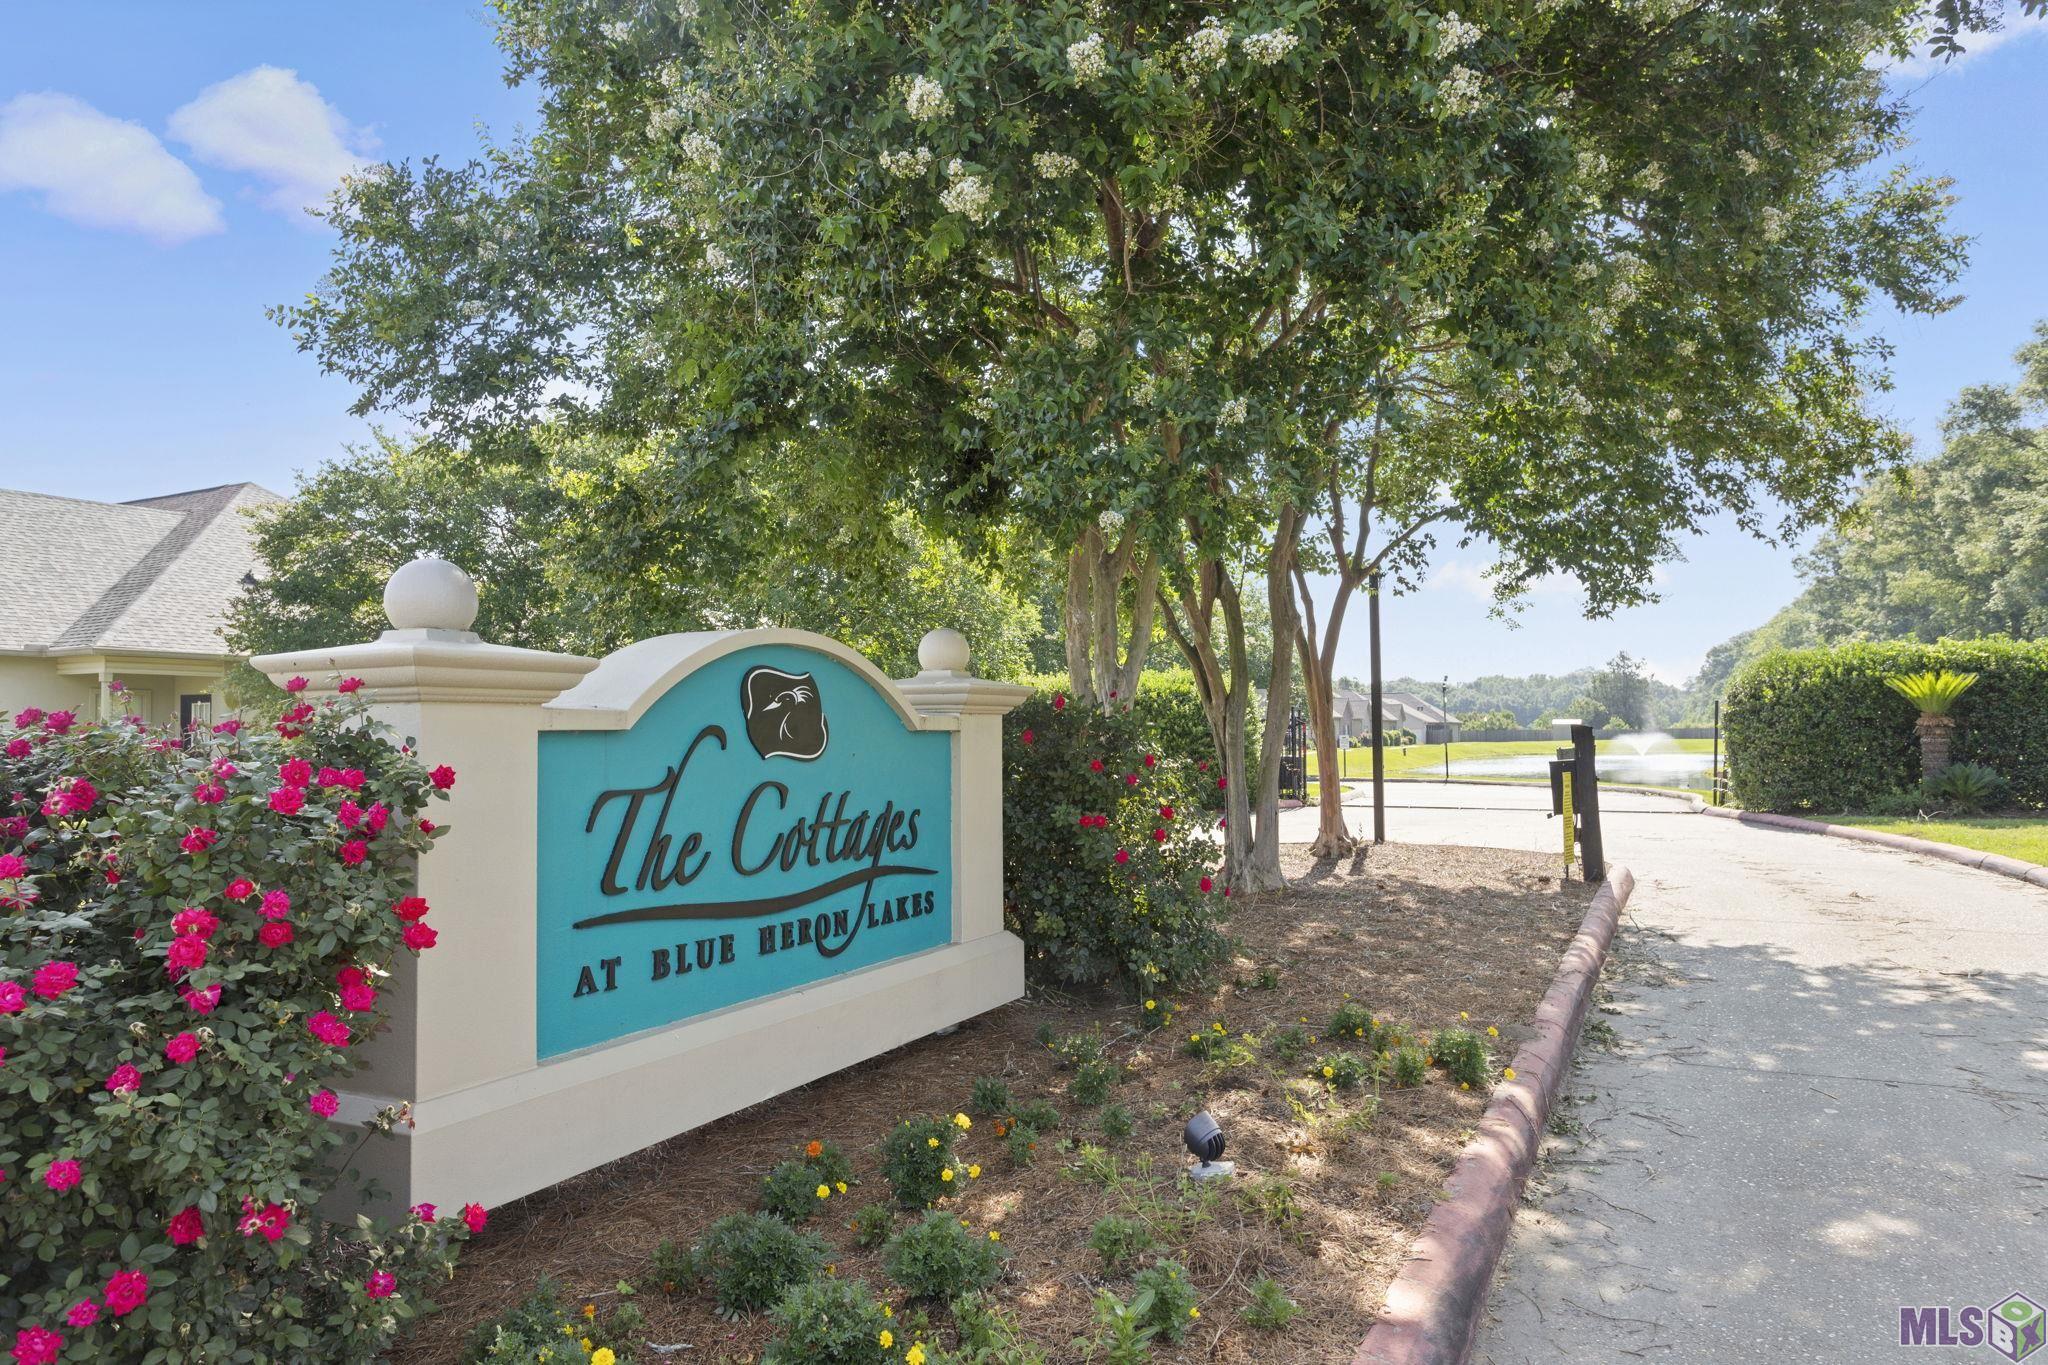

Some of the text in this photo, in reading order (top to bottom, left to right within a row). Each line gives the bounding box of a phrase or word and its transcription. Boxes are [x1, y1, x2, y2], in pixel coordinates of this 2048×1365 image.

[585, 724, 921, 957] The Cottages
[573, 890, 935, 998] AT BLUE HERON LAKES
